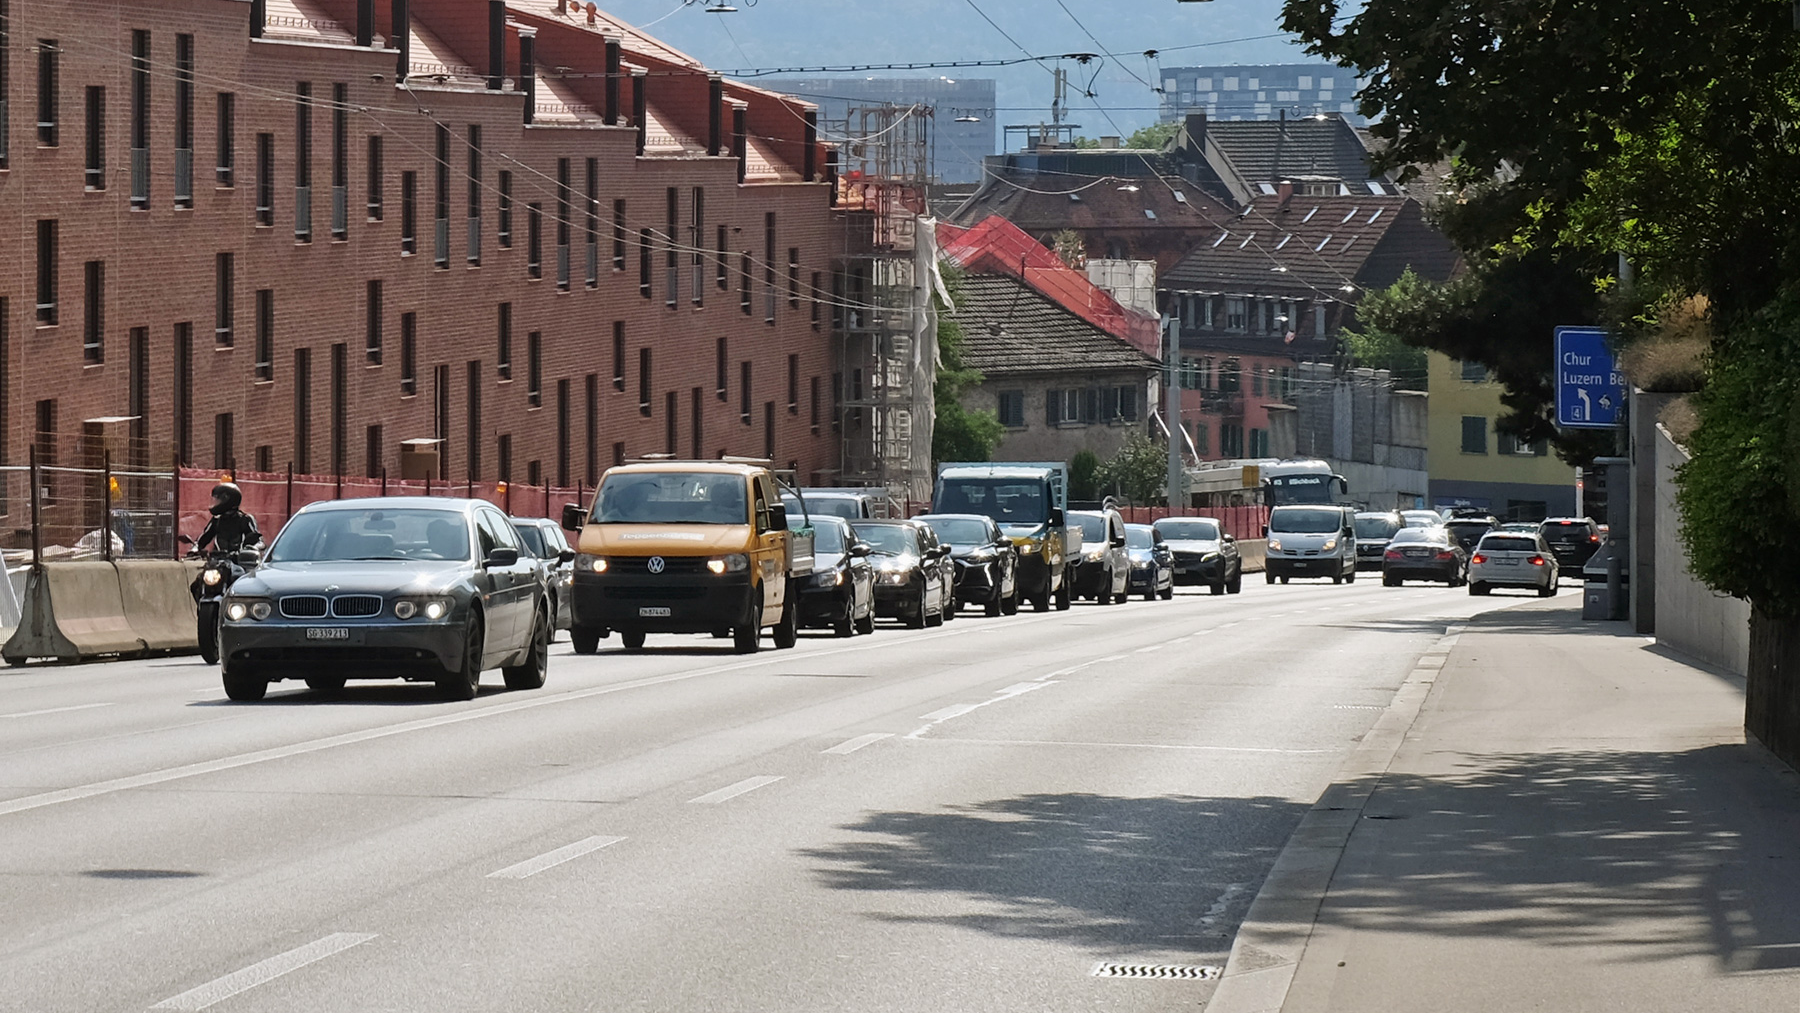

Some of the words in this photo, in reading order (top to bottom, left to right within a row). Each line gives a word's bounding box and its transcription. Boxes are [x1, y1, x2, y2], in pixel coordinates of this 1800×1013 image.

[1563, 352, 1591, 366] Chur
[1563, 371, 1602, 385] Luzern
[1573, 408, 1580, 419] 4
